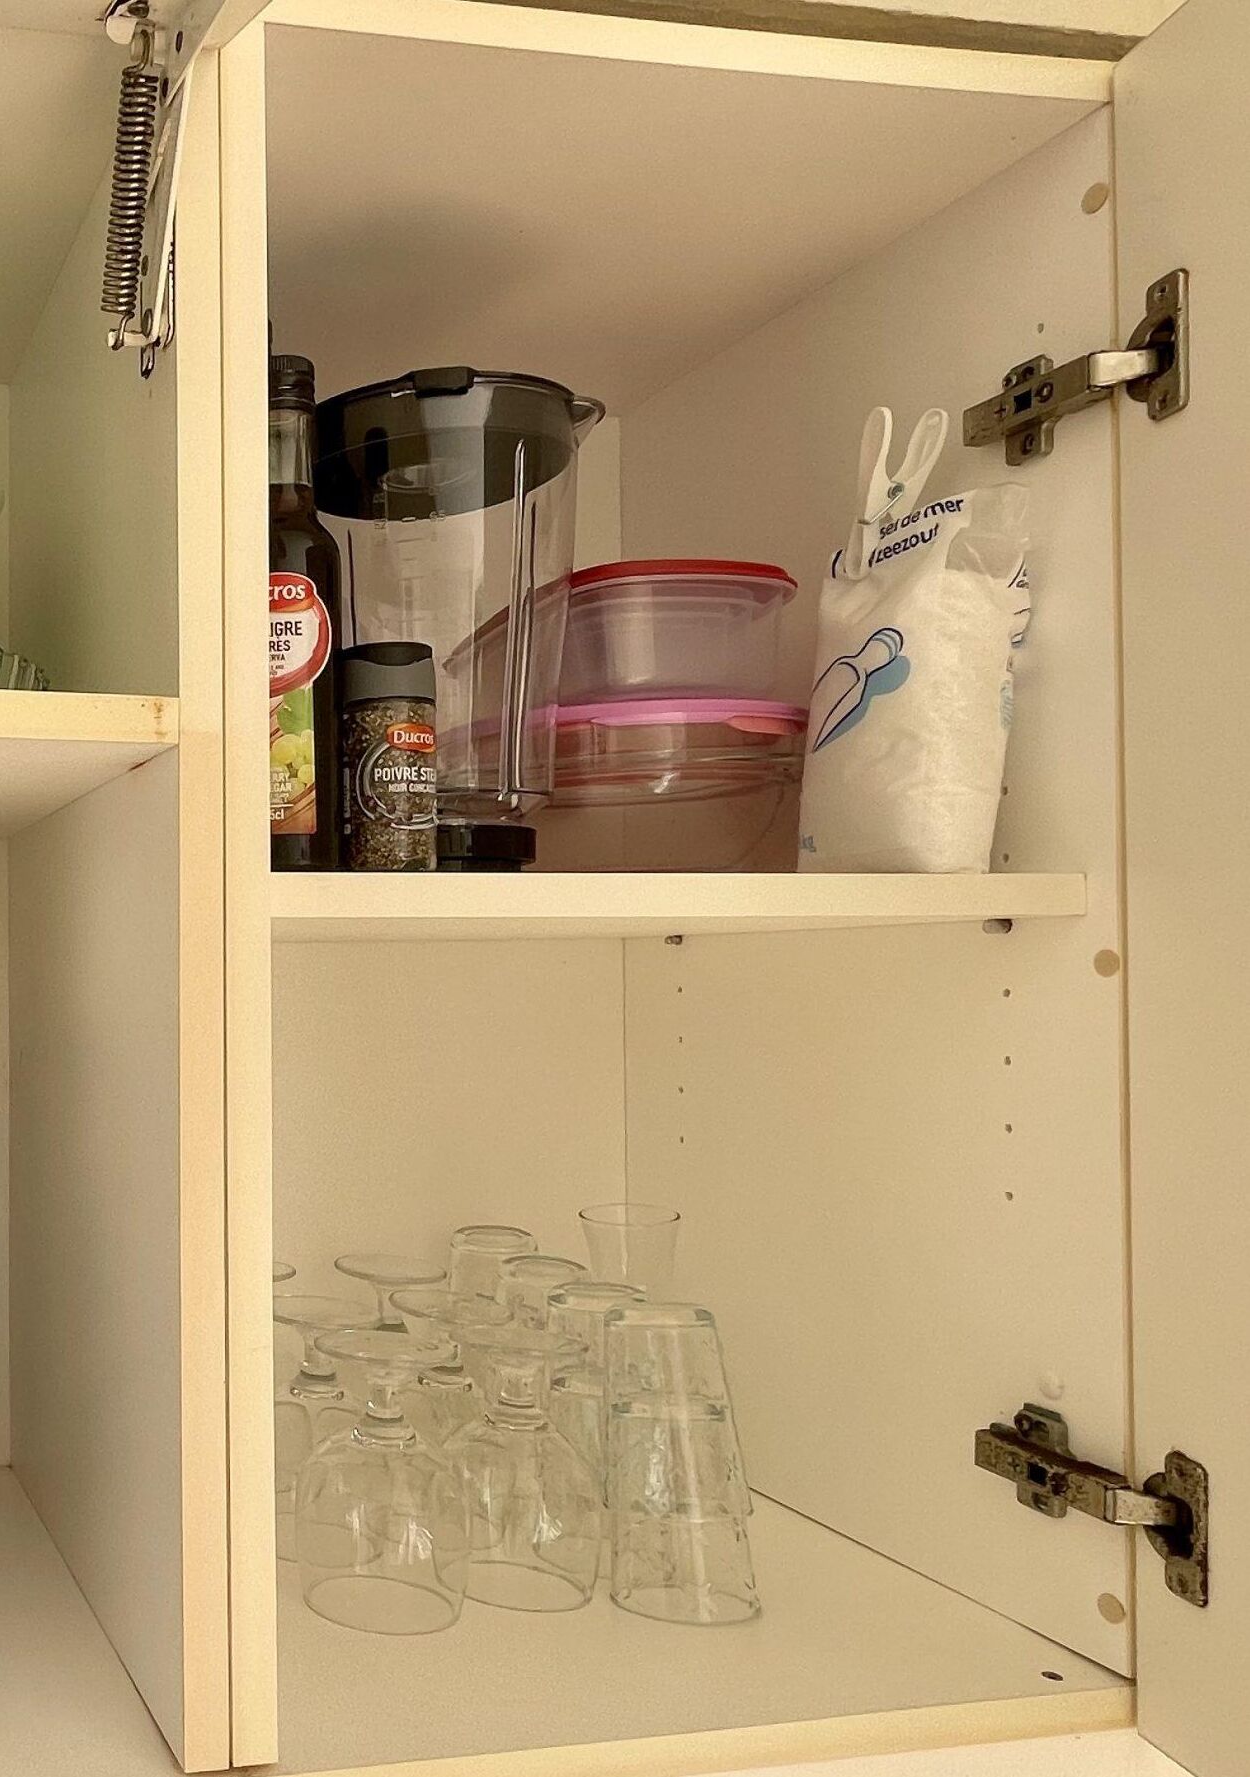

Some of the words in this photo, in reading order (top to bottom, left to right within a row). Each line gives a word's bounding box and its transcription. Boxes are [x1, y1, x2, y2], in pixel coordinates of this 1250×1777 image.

[923, 498, 964, 519] mer
[393, 729, 435, 746] Ducros
[374, 765, 419, 782] POIVRE
